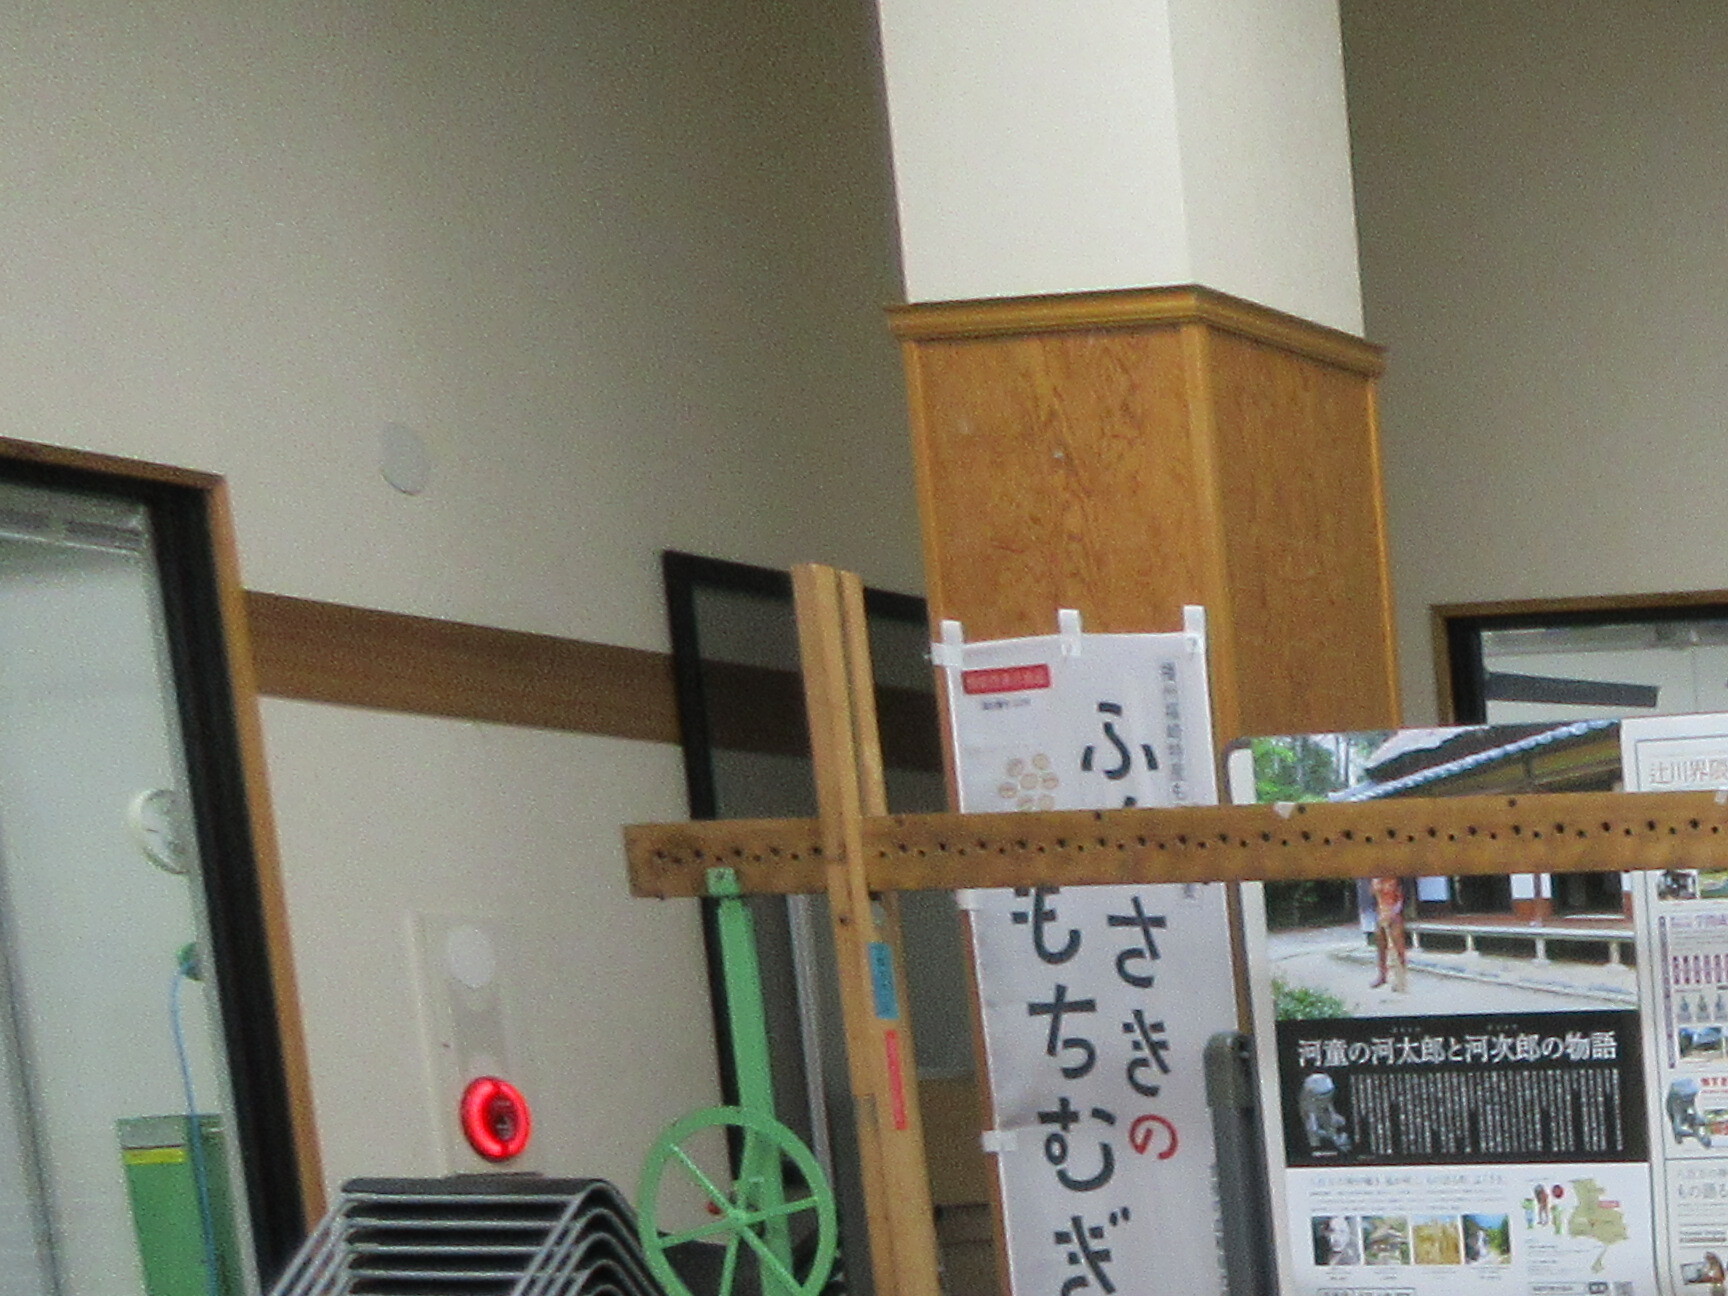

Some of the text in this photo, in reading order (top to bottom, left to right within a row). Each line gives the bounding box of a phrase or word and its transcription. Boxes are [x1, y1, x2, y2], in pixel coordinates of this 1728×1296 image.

[1081, 701, 1180, 1160] ふさきの
[1298, 1030, 1618, 1068] 河童の河太郎と河次郎の物語
